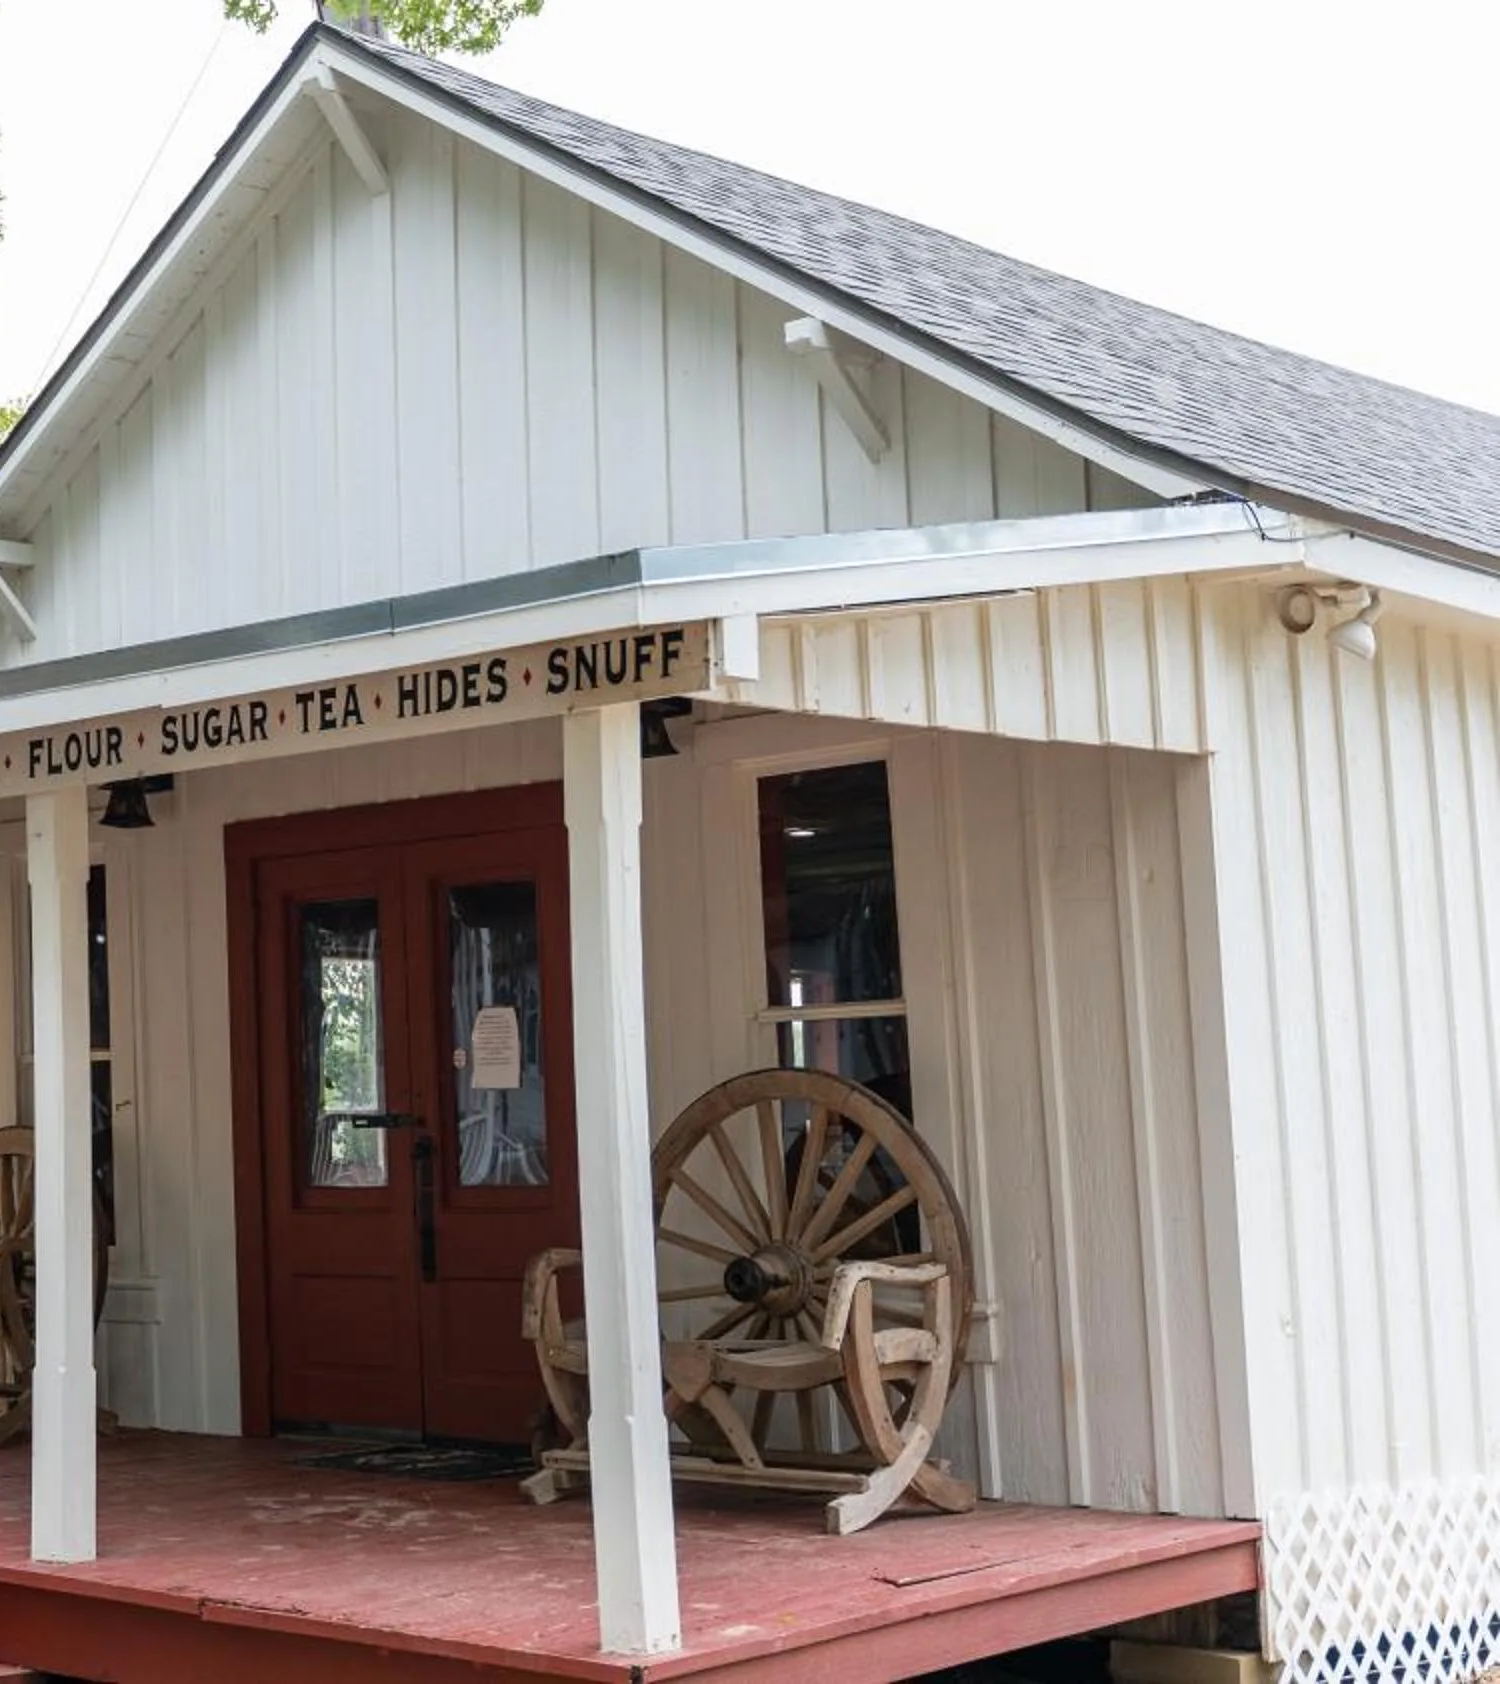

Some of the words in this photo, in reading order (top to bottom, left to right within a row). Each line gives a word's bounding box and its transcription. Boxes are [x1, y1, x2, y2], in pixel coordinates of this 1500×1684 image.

[28, 726, 123, 778] FLOUR
[161, 701, 268, 755] SUGAR
[296, 684, 364, 732] TEA
[396, 659, 508, 718] HIDES
[546, 629, 684, 694] SNUFF
